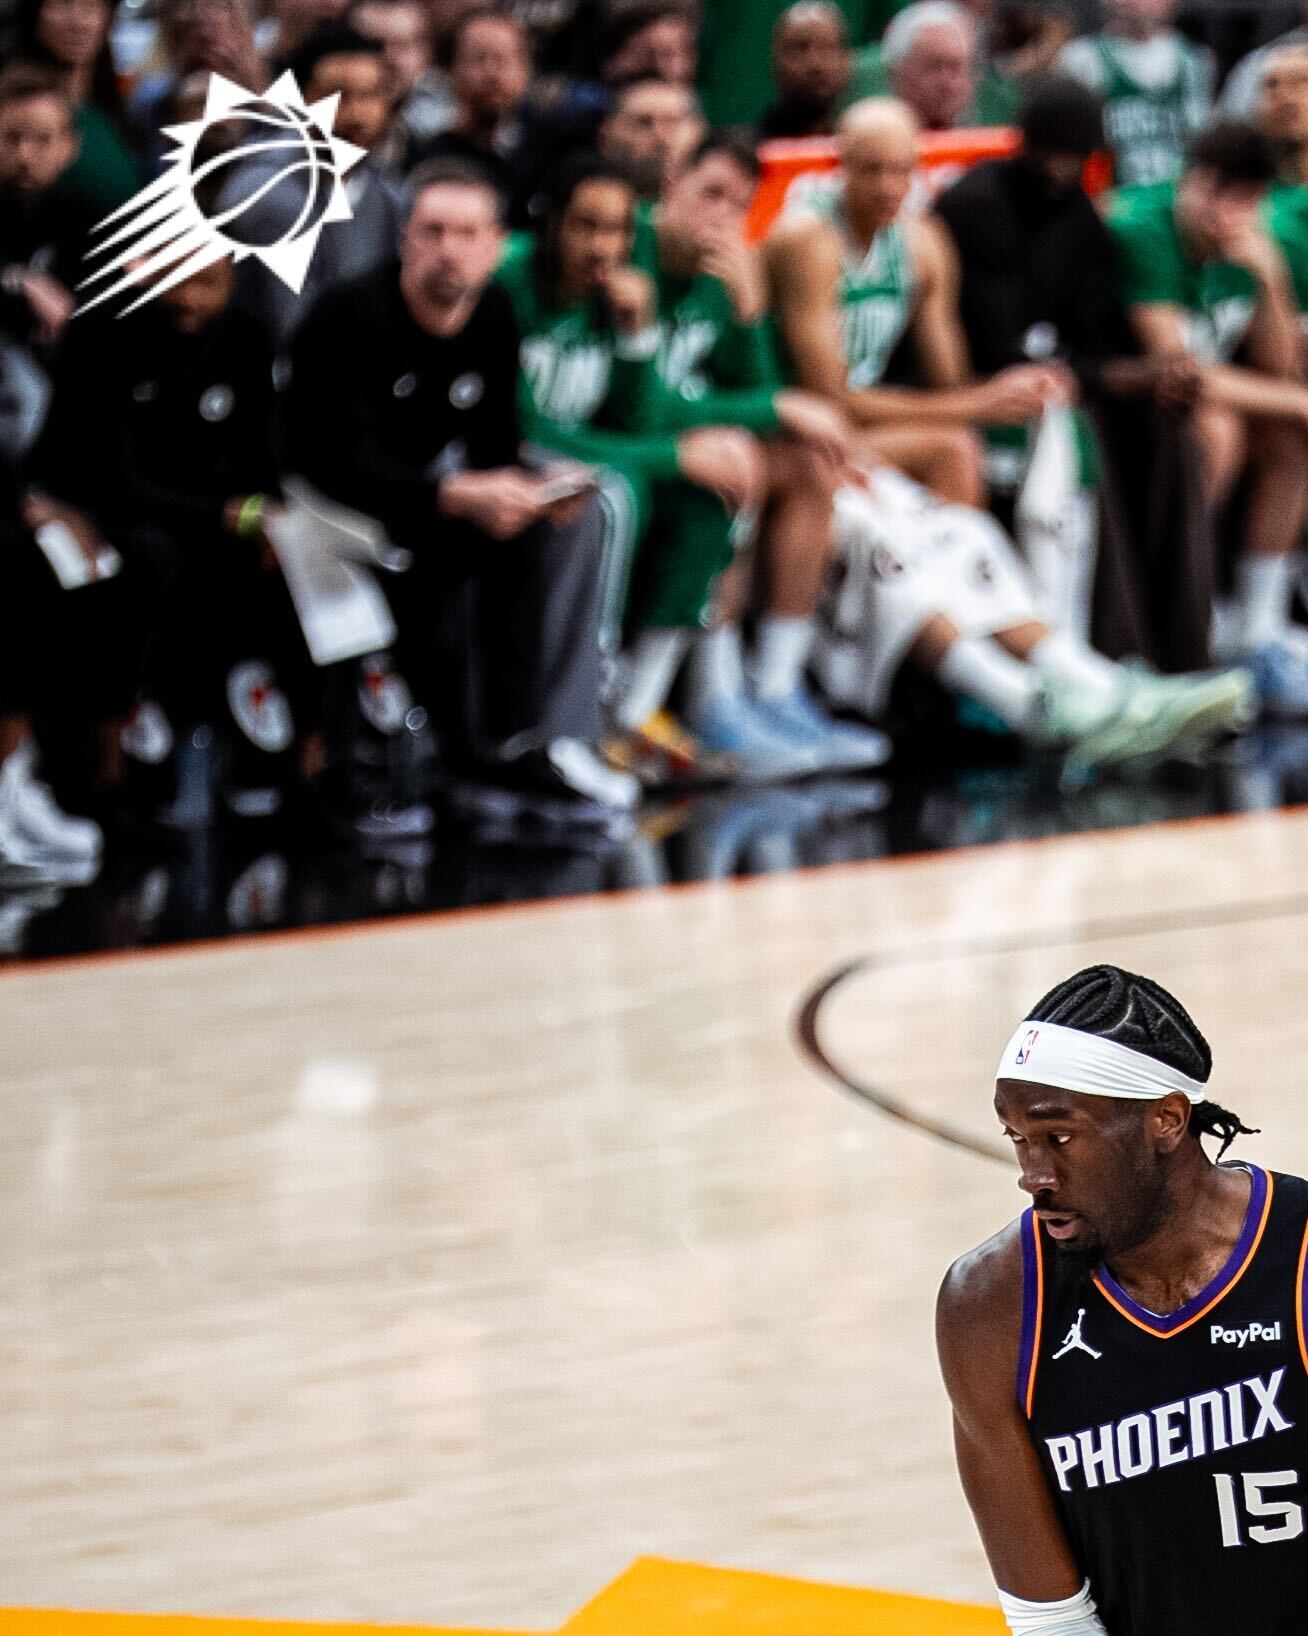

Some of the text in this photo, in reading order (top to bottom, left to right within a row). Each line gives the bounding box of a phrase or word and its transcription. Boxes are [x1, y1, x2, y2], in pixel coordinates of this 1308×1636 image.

[1210, 1321, 1281, 1349] PayPal
[1045, 1366, 1295, 1492] PHOENIX
[1213, 1469, 1304, 1548] 15
